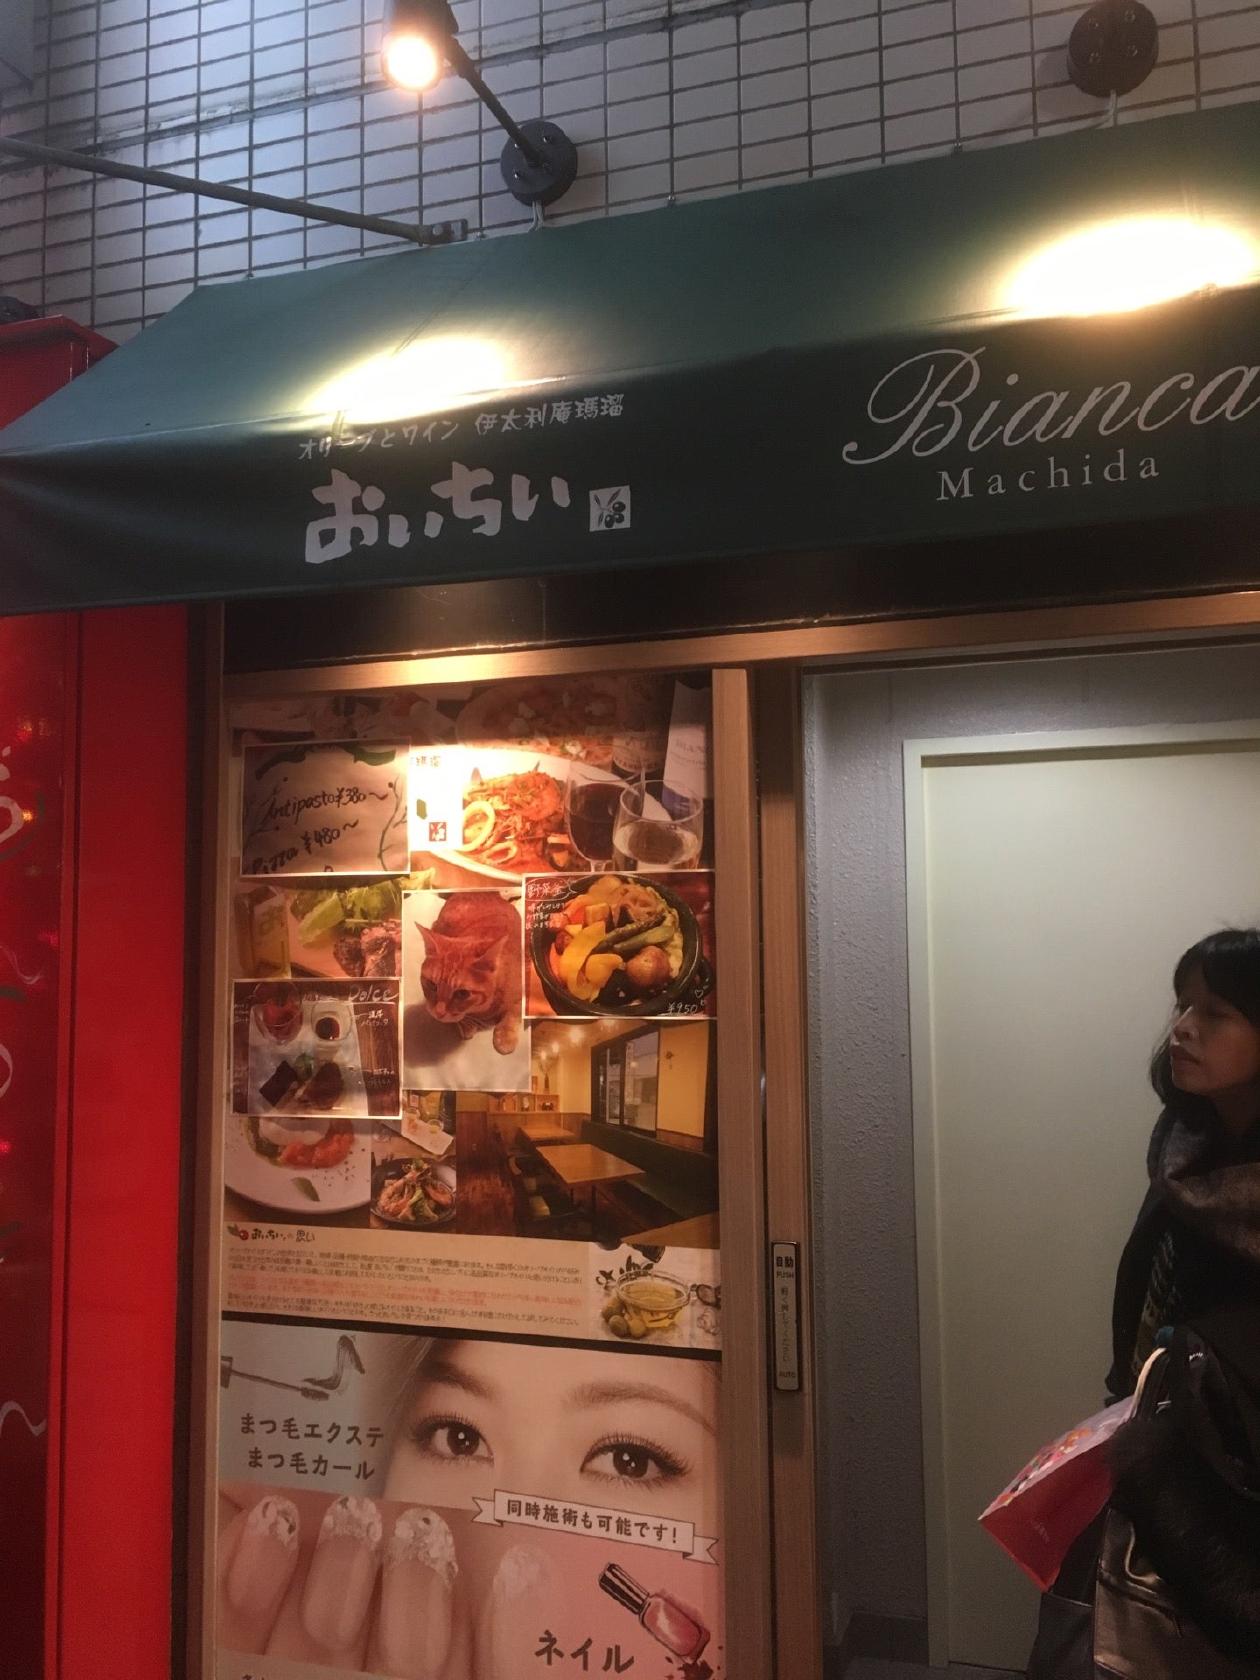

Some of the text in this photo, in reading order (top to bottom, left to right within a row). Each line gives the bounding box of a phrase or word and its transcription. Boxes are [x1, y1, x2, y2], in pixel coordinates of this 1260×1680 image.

[842, 346, 1260, 465] Bianca
[936, 448, 1160, 501] Machida
[776, 1256, 794, 1268] 自動
[241, 1413, 384, 1447] まつ毛エクステ
[248, 1447, 375, 1480] まつ毛カール
[535, 1629, 635, 1674] ネイル
